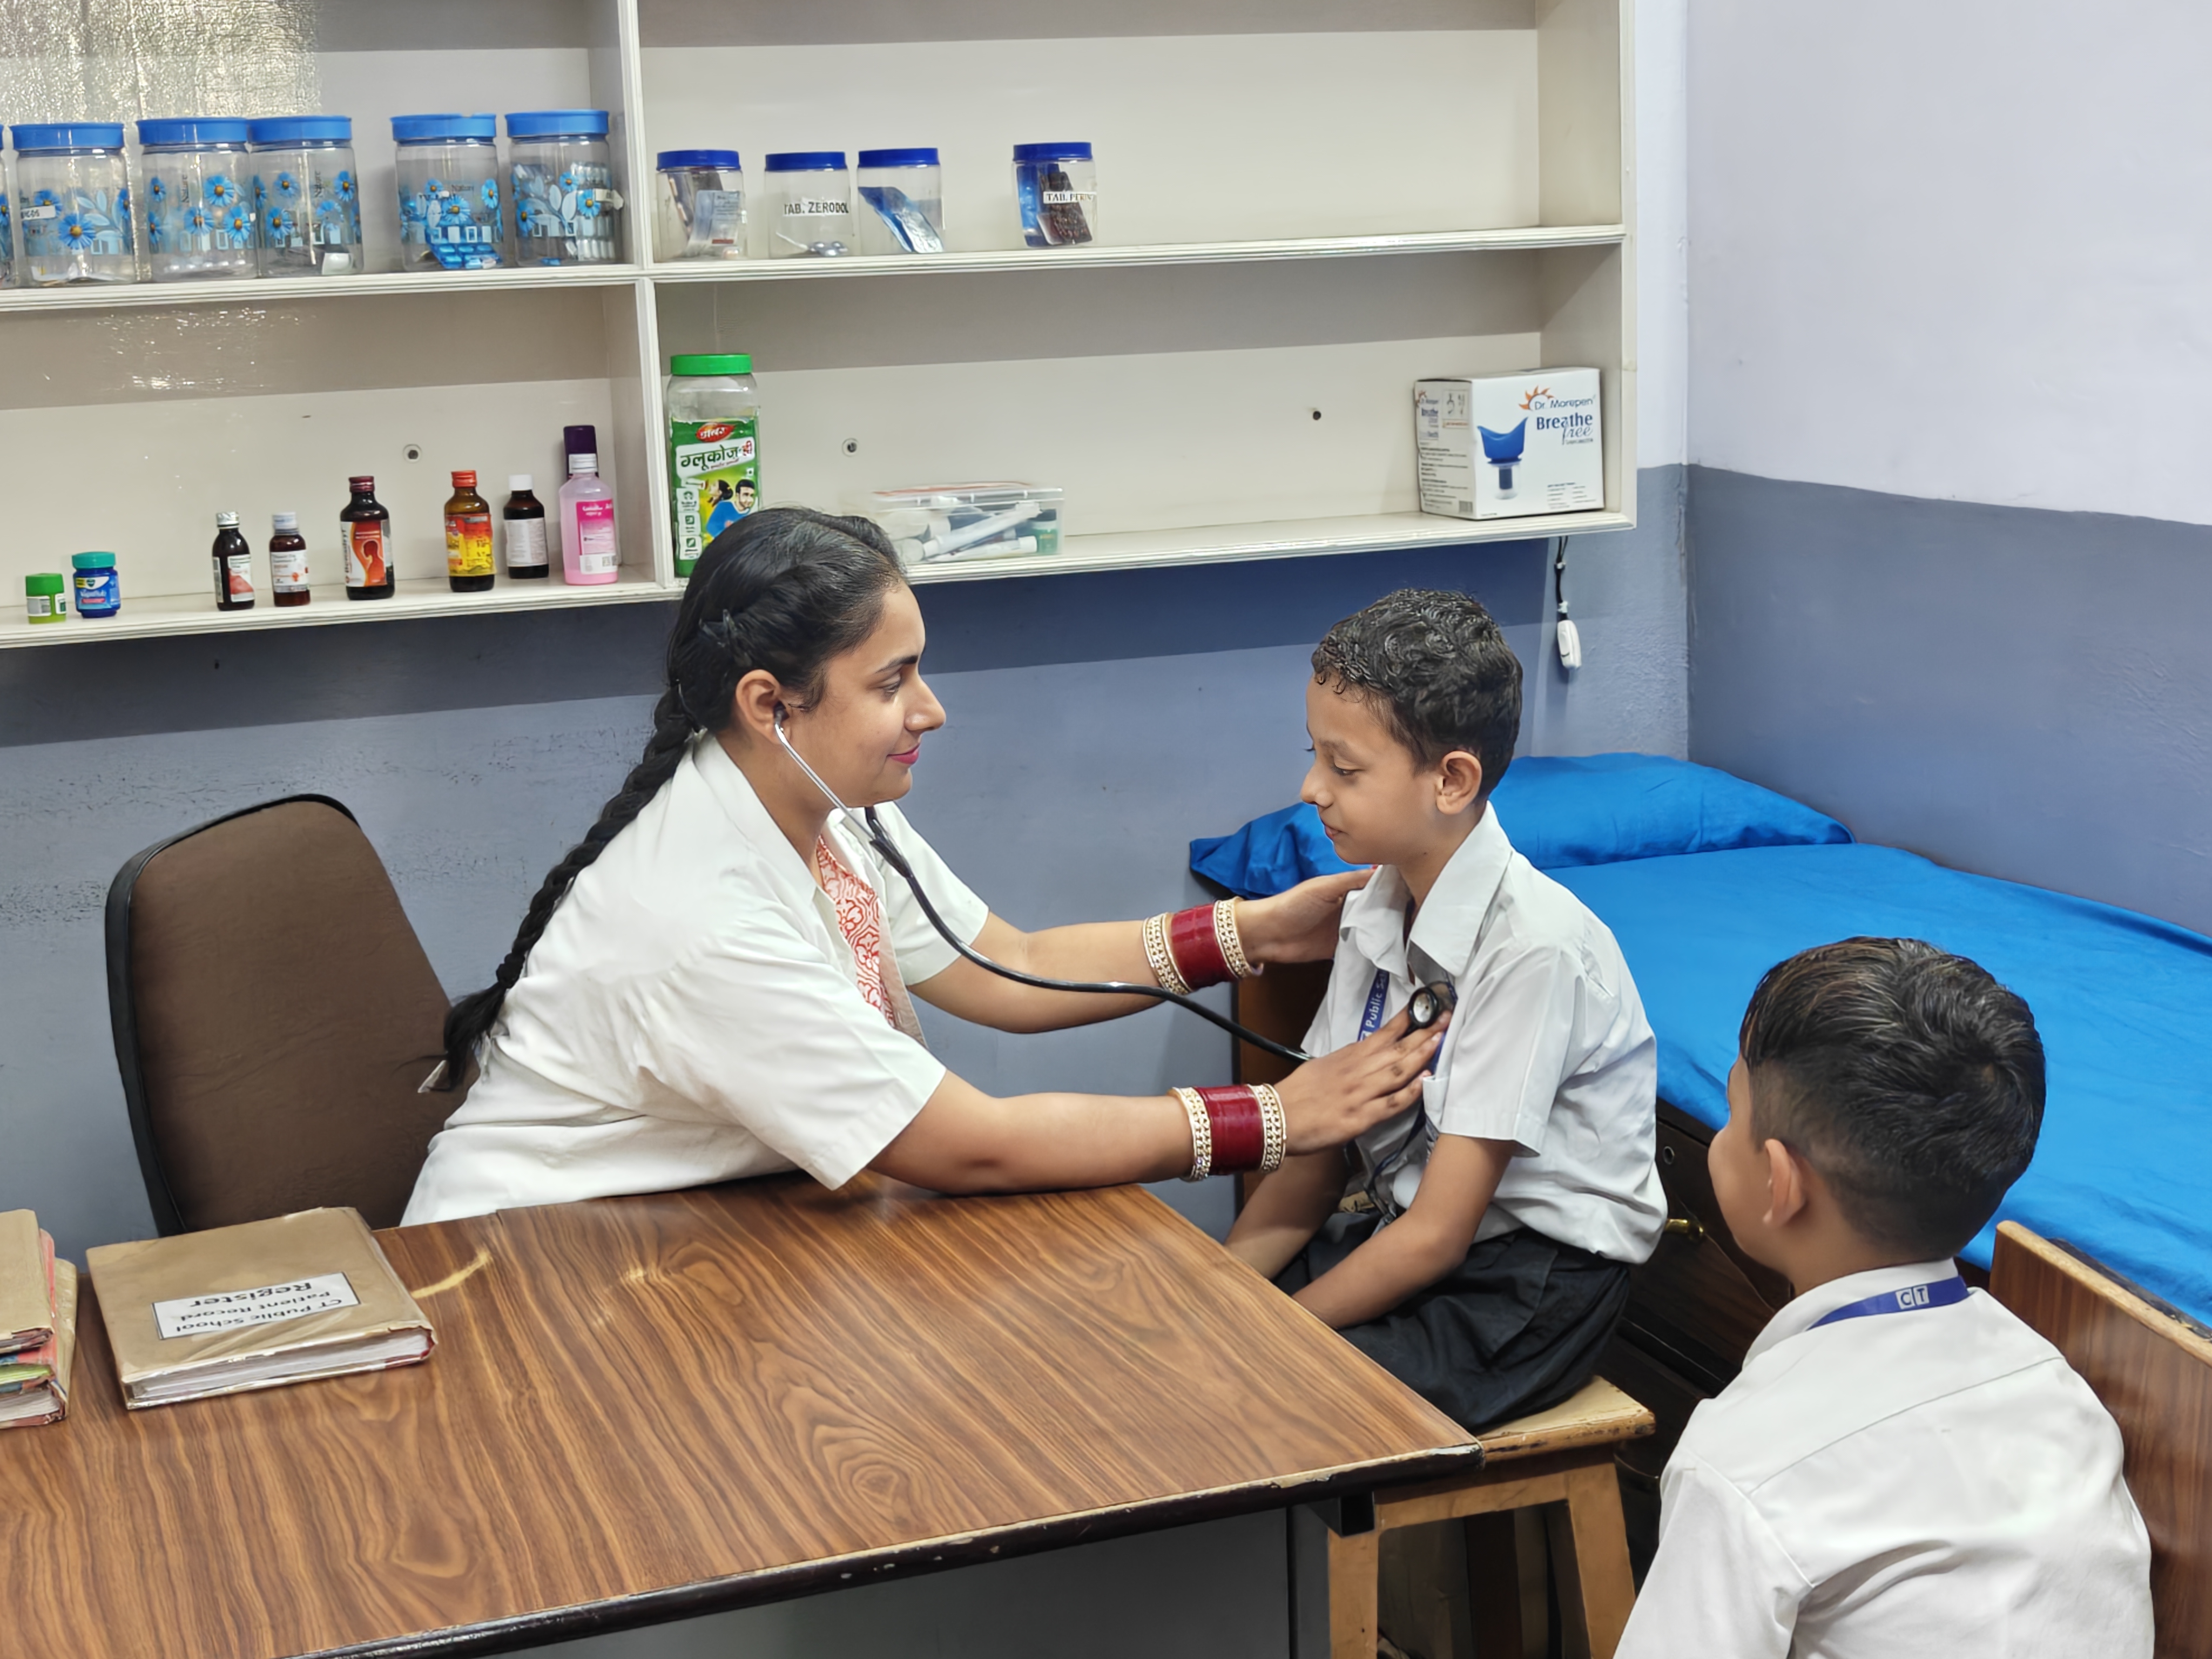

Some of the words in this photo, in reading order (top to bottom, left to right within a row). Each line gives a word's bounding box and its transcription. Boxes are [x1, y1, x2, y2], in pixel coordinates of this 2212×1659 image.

[1550, 398, 1593, 409] Morepen
[1536, 412, 1593, 430] Breathe
[1365, 993, 1382, 1028] Public
[189, 1282, 312, 1307] Register
[258, 1291, 330, 1310] Patient
[1900, 1287, 1925, 1305] CT
[318, 1299, 342, 1309] CT
[180, 1306, 252, 1321] Record
[250, 1305, 312, 1320] Public
[176, 1318, 244, 1332] School
